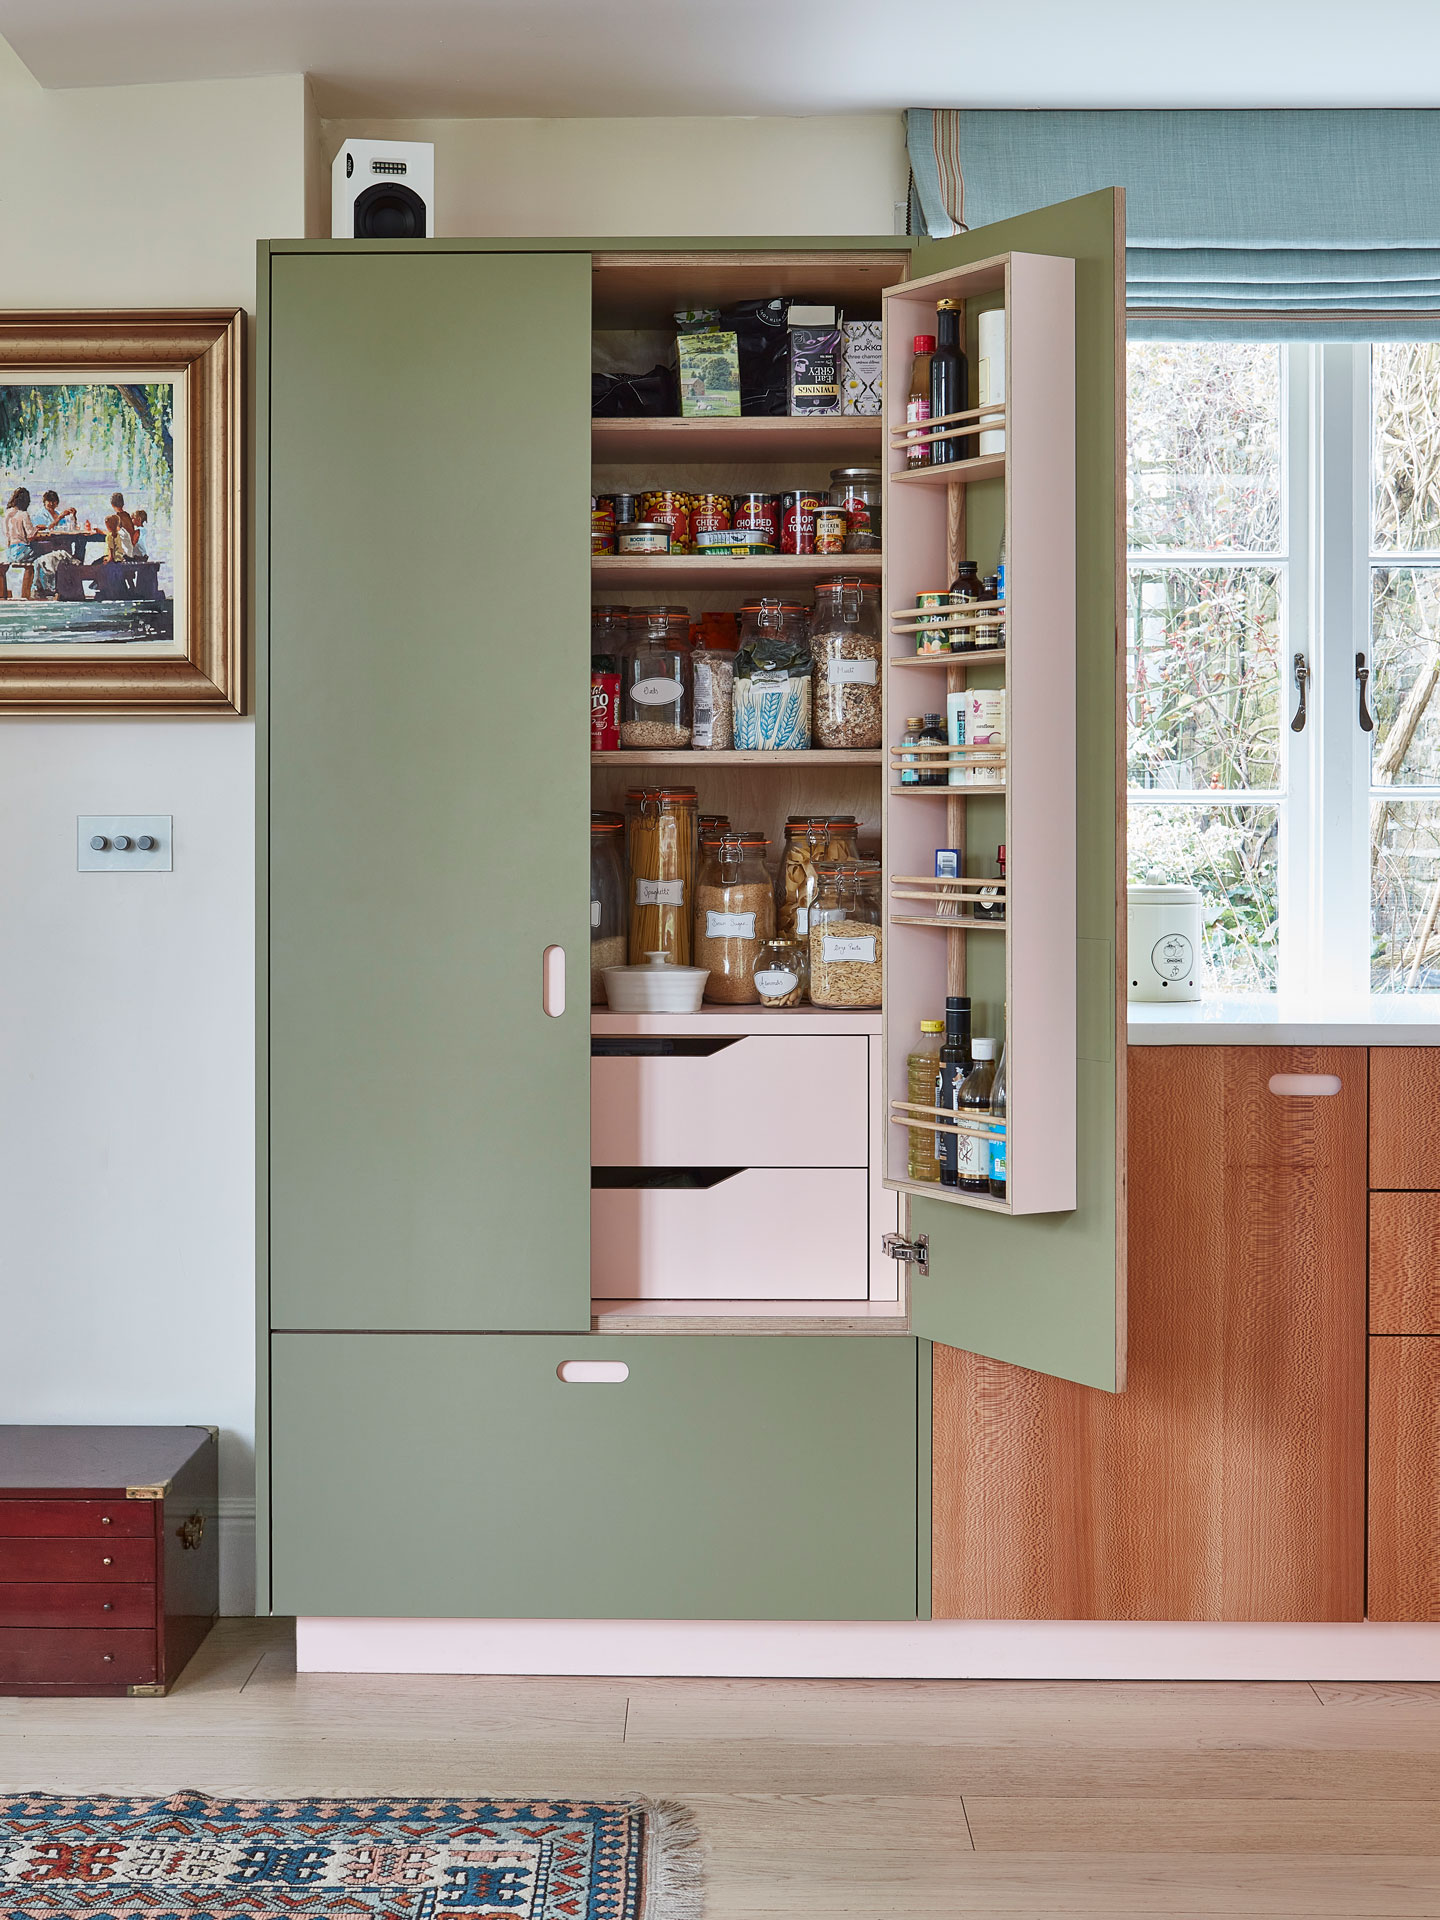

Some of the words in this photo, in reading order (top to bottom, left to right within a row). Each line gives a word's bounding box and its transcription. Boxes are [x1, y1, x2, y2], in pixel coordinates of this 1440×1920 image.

[808, 366, 835, 376] GREY
[815, 375, 832, 384] Earl
[798, 386, 836, 394] TWININGS
[653, 516, 677, 524] CHICK
[736, 518, 772, 527] CHOPPED
[644, 886, 670, 900] Spaghetti
